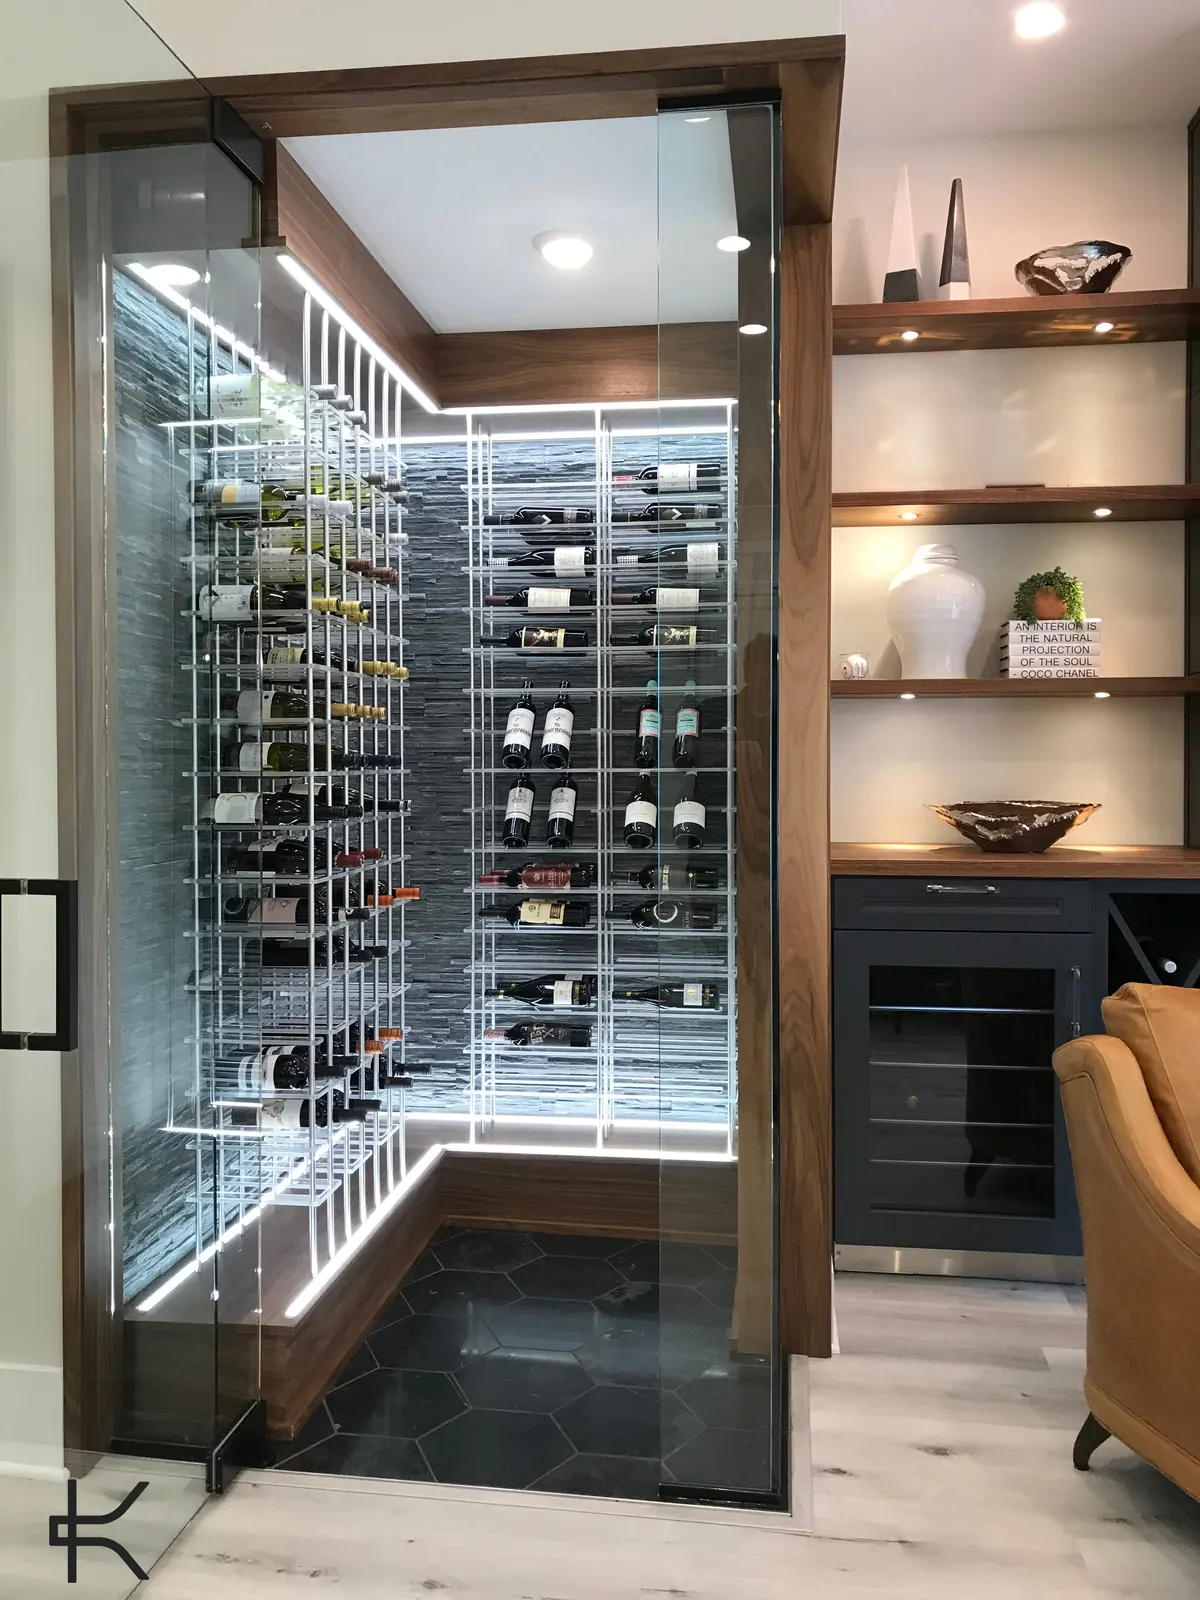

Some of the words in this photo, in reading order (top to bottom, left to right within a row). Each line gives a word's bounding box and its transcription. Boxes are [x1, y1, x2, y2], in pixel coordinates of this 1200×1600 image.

[1014, 622, 1030, 631] AN
[1033, 622, 1083, 631] INTERIOR
[1087, 622, 1097, 630] IS
[1019, 634, 1040, 643] THE
[1043, 633, 1093, 643] NATURAL
[1022, 645, 1090, 655] PROJECTION
[1020, 657, 1035, 667] OF
[1039, 657, 1060, 666] THE
[1063, 657, 1093, 666] SOUL
[1020, 669, 1053, 679] COCO
[1055, 668, 1099, 678] CHANEL
